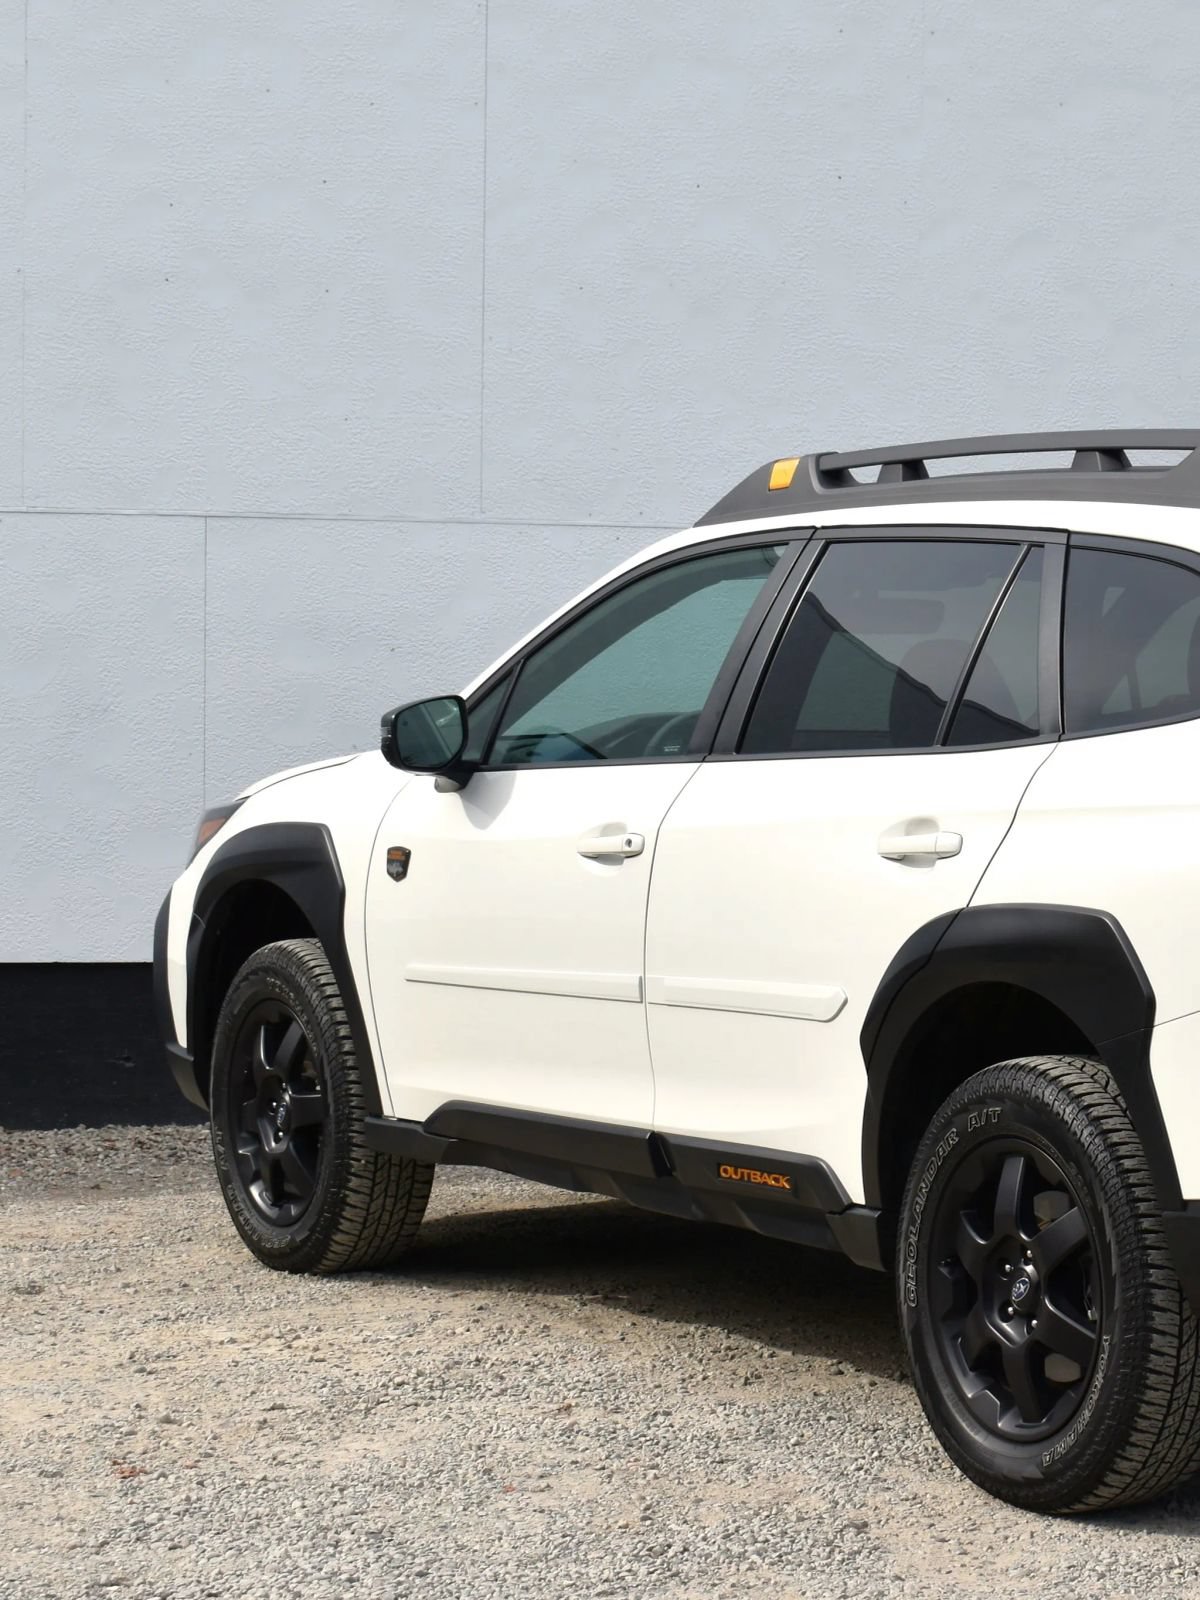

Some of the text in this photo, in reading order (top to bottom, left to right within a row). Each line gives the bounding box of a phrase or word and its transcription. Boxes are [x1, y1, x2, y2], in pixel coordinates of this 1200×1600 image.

[719, 1165, 791, 1188] OUTBACK
[905, 1107, 1002, 1308] GEOLANDAR A/T
[1041, 1335, 1112, 1467] YOKOHAMA
